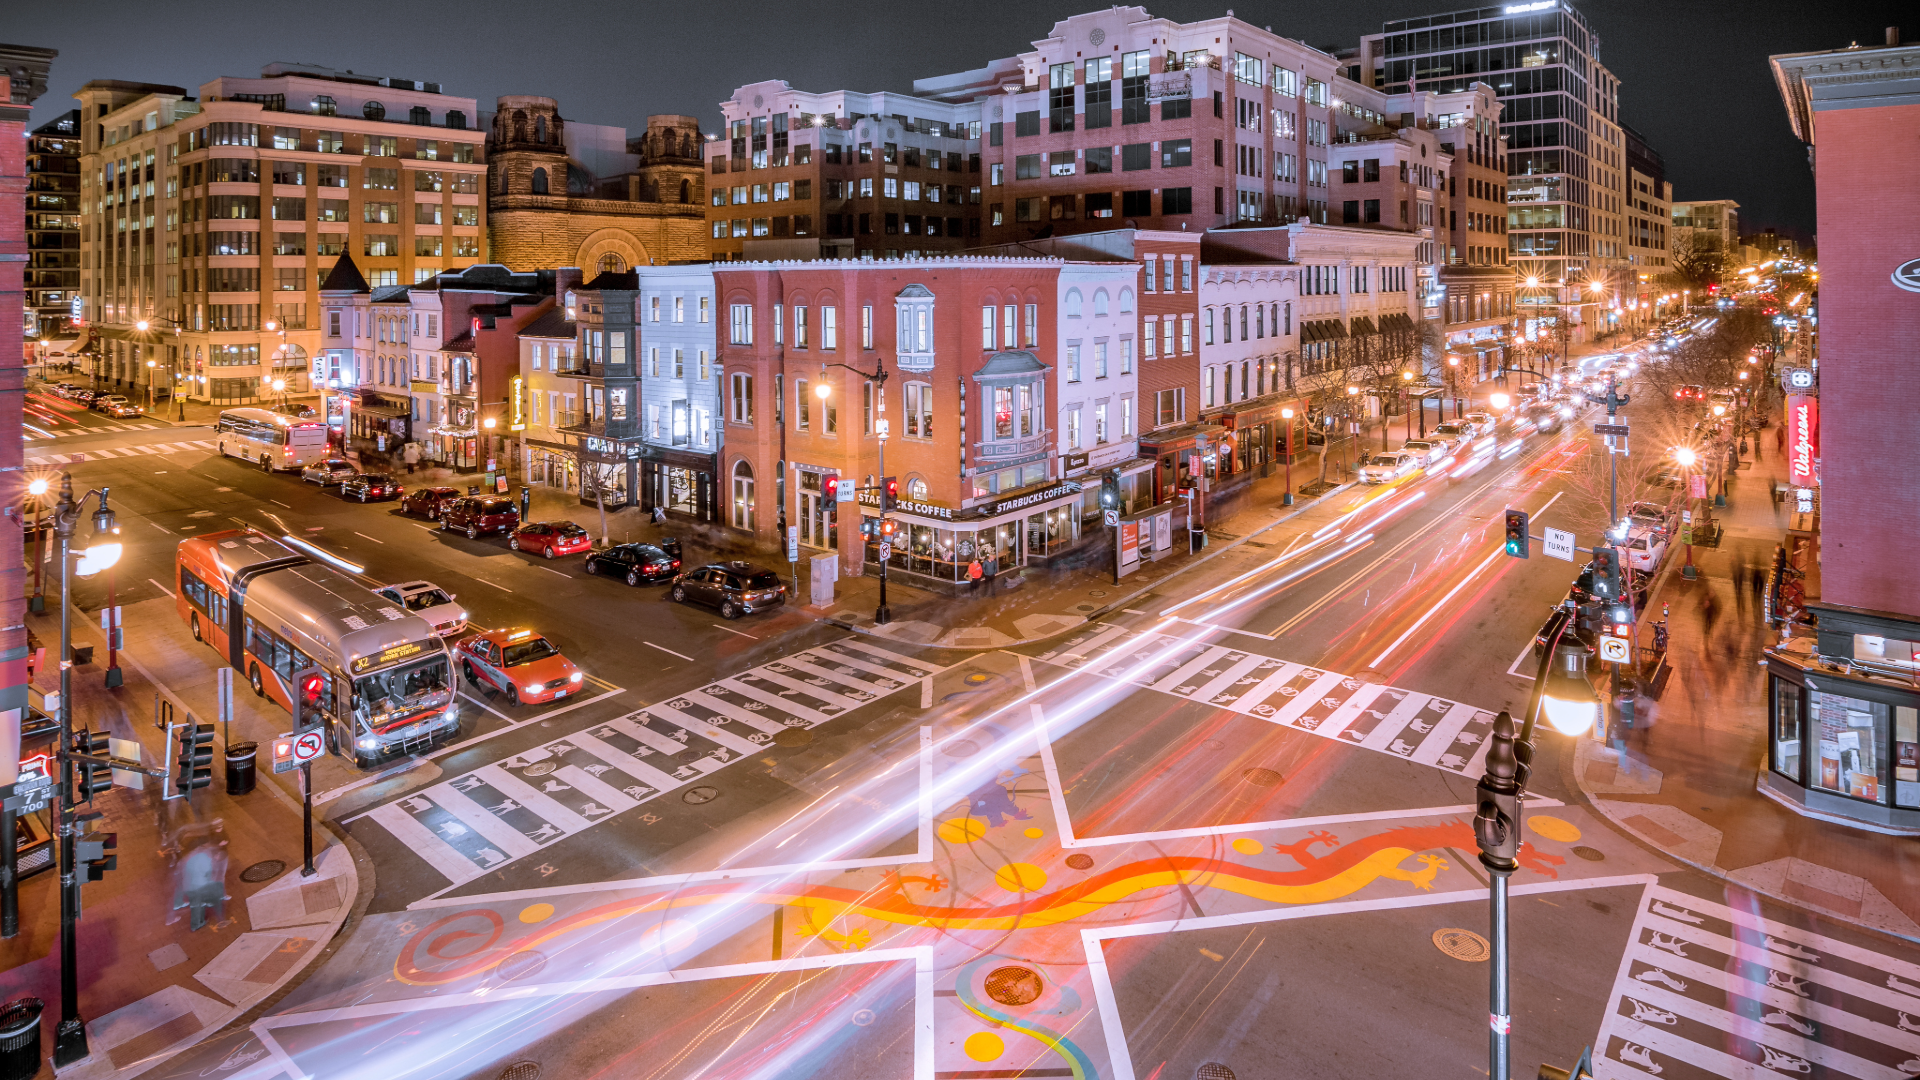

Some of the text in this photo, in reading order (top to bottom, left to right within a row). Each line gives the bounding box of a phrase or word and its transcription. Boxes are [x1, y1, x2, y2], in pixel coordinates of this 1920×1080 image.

[587, 437, 608, 453] CAVA
[1793, 405, 1814, 476] Walgreens
[997, 485, 1071, 513] STARBUCKS COFFEE
[915, 503, 952, 518] COFFEE
[1554, 533, 1565, 542] NO
[1548, 541, 1570, 554] TURNS
[400, 646, 421, 657] STATION
[357, 657, 370, 669] X2
[24, 792, 35, 805] 7
[21, 800, 44, 814] 700
